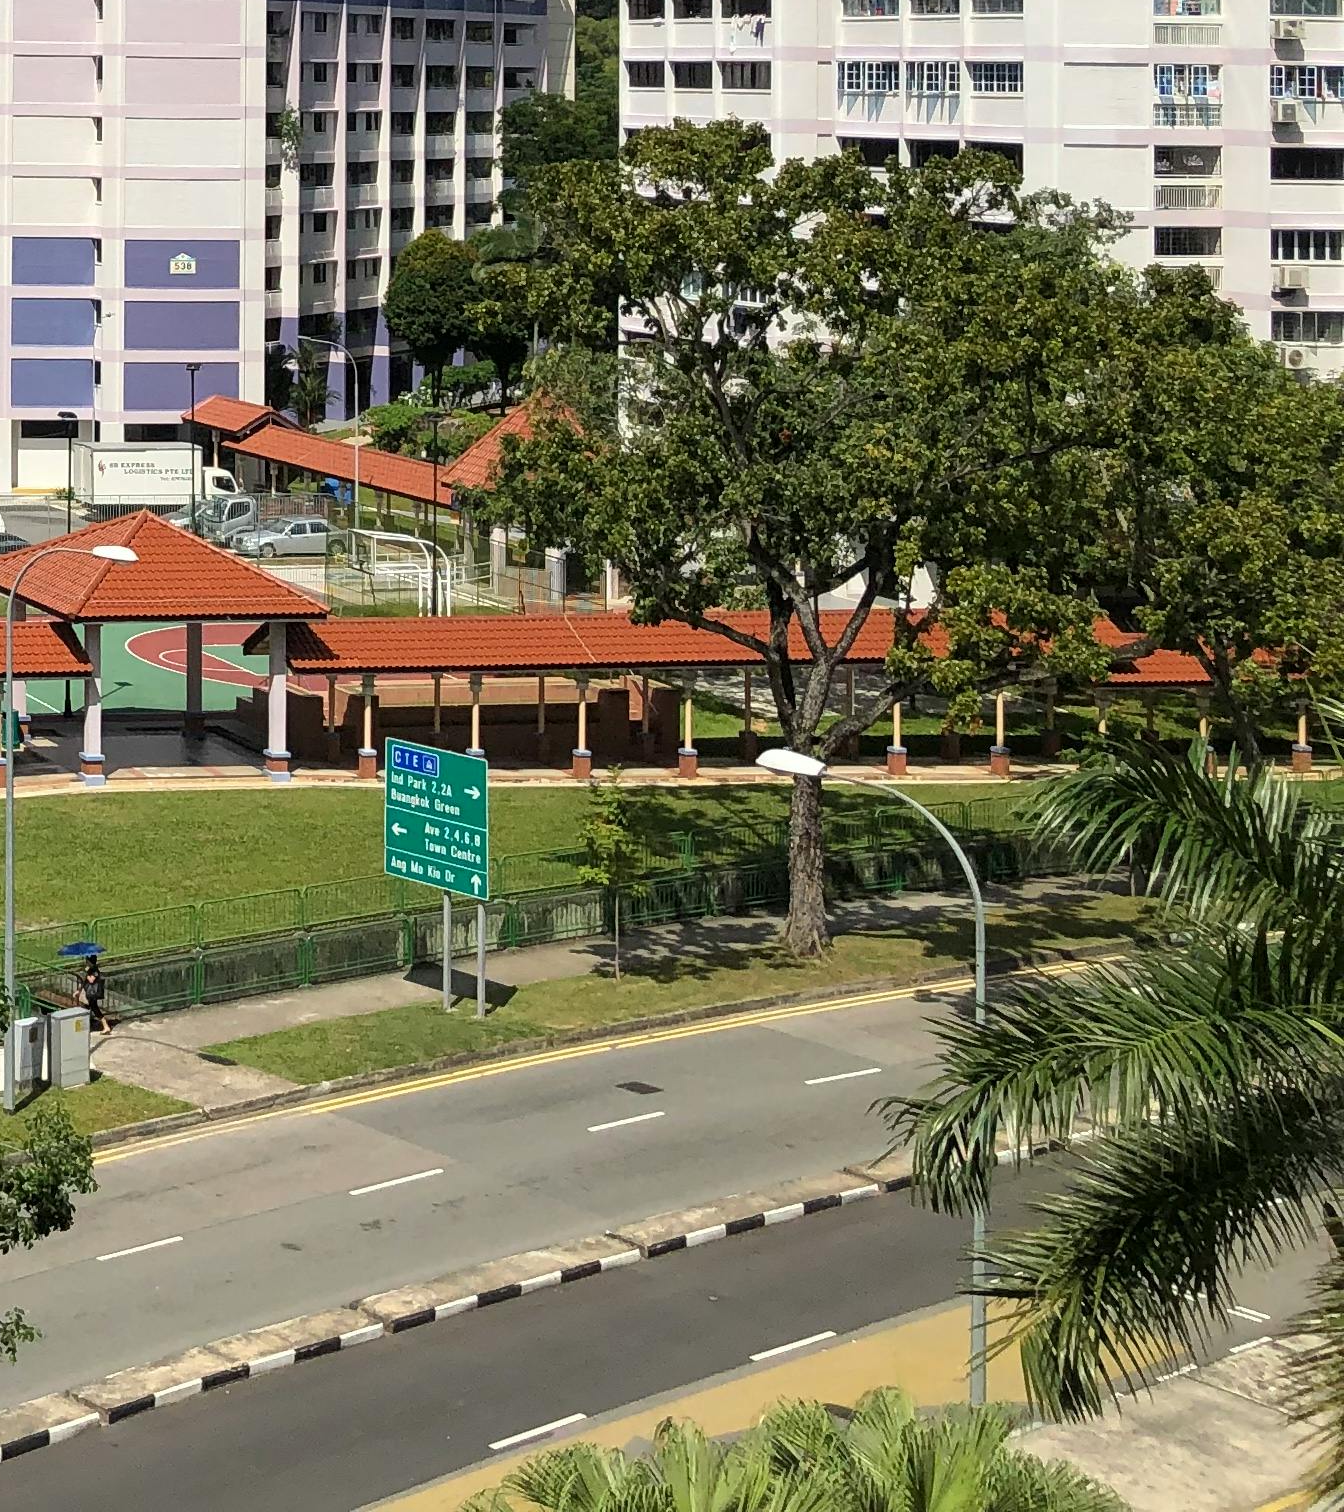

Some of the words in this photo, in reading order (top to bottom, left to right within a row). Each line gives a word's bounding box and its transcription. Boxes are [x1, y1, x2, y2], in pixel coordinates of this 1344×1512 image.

[174, 262, 192, 270] 538
[395, 751, 419, 767] CTE
[391, 771, 403, 785] Ind
[408, 775, 427, 790] Park
[391, 788, 430, 808] Buangkok
[434, 799, 460, 816] Green
[424, 821, 440, 837] Ave
[425, 838, 447, 855] Town
[451, 845, 481, 864] Centre
[391, 855, 407, 873] Ang
[410, 860, 424, 875] Mo
[427, 864, 441, 879] Kio
[444, 869, 456, 883] Dr
